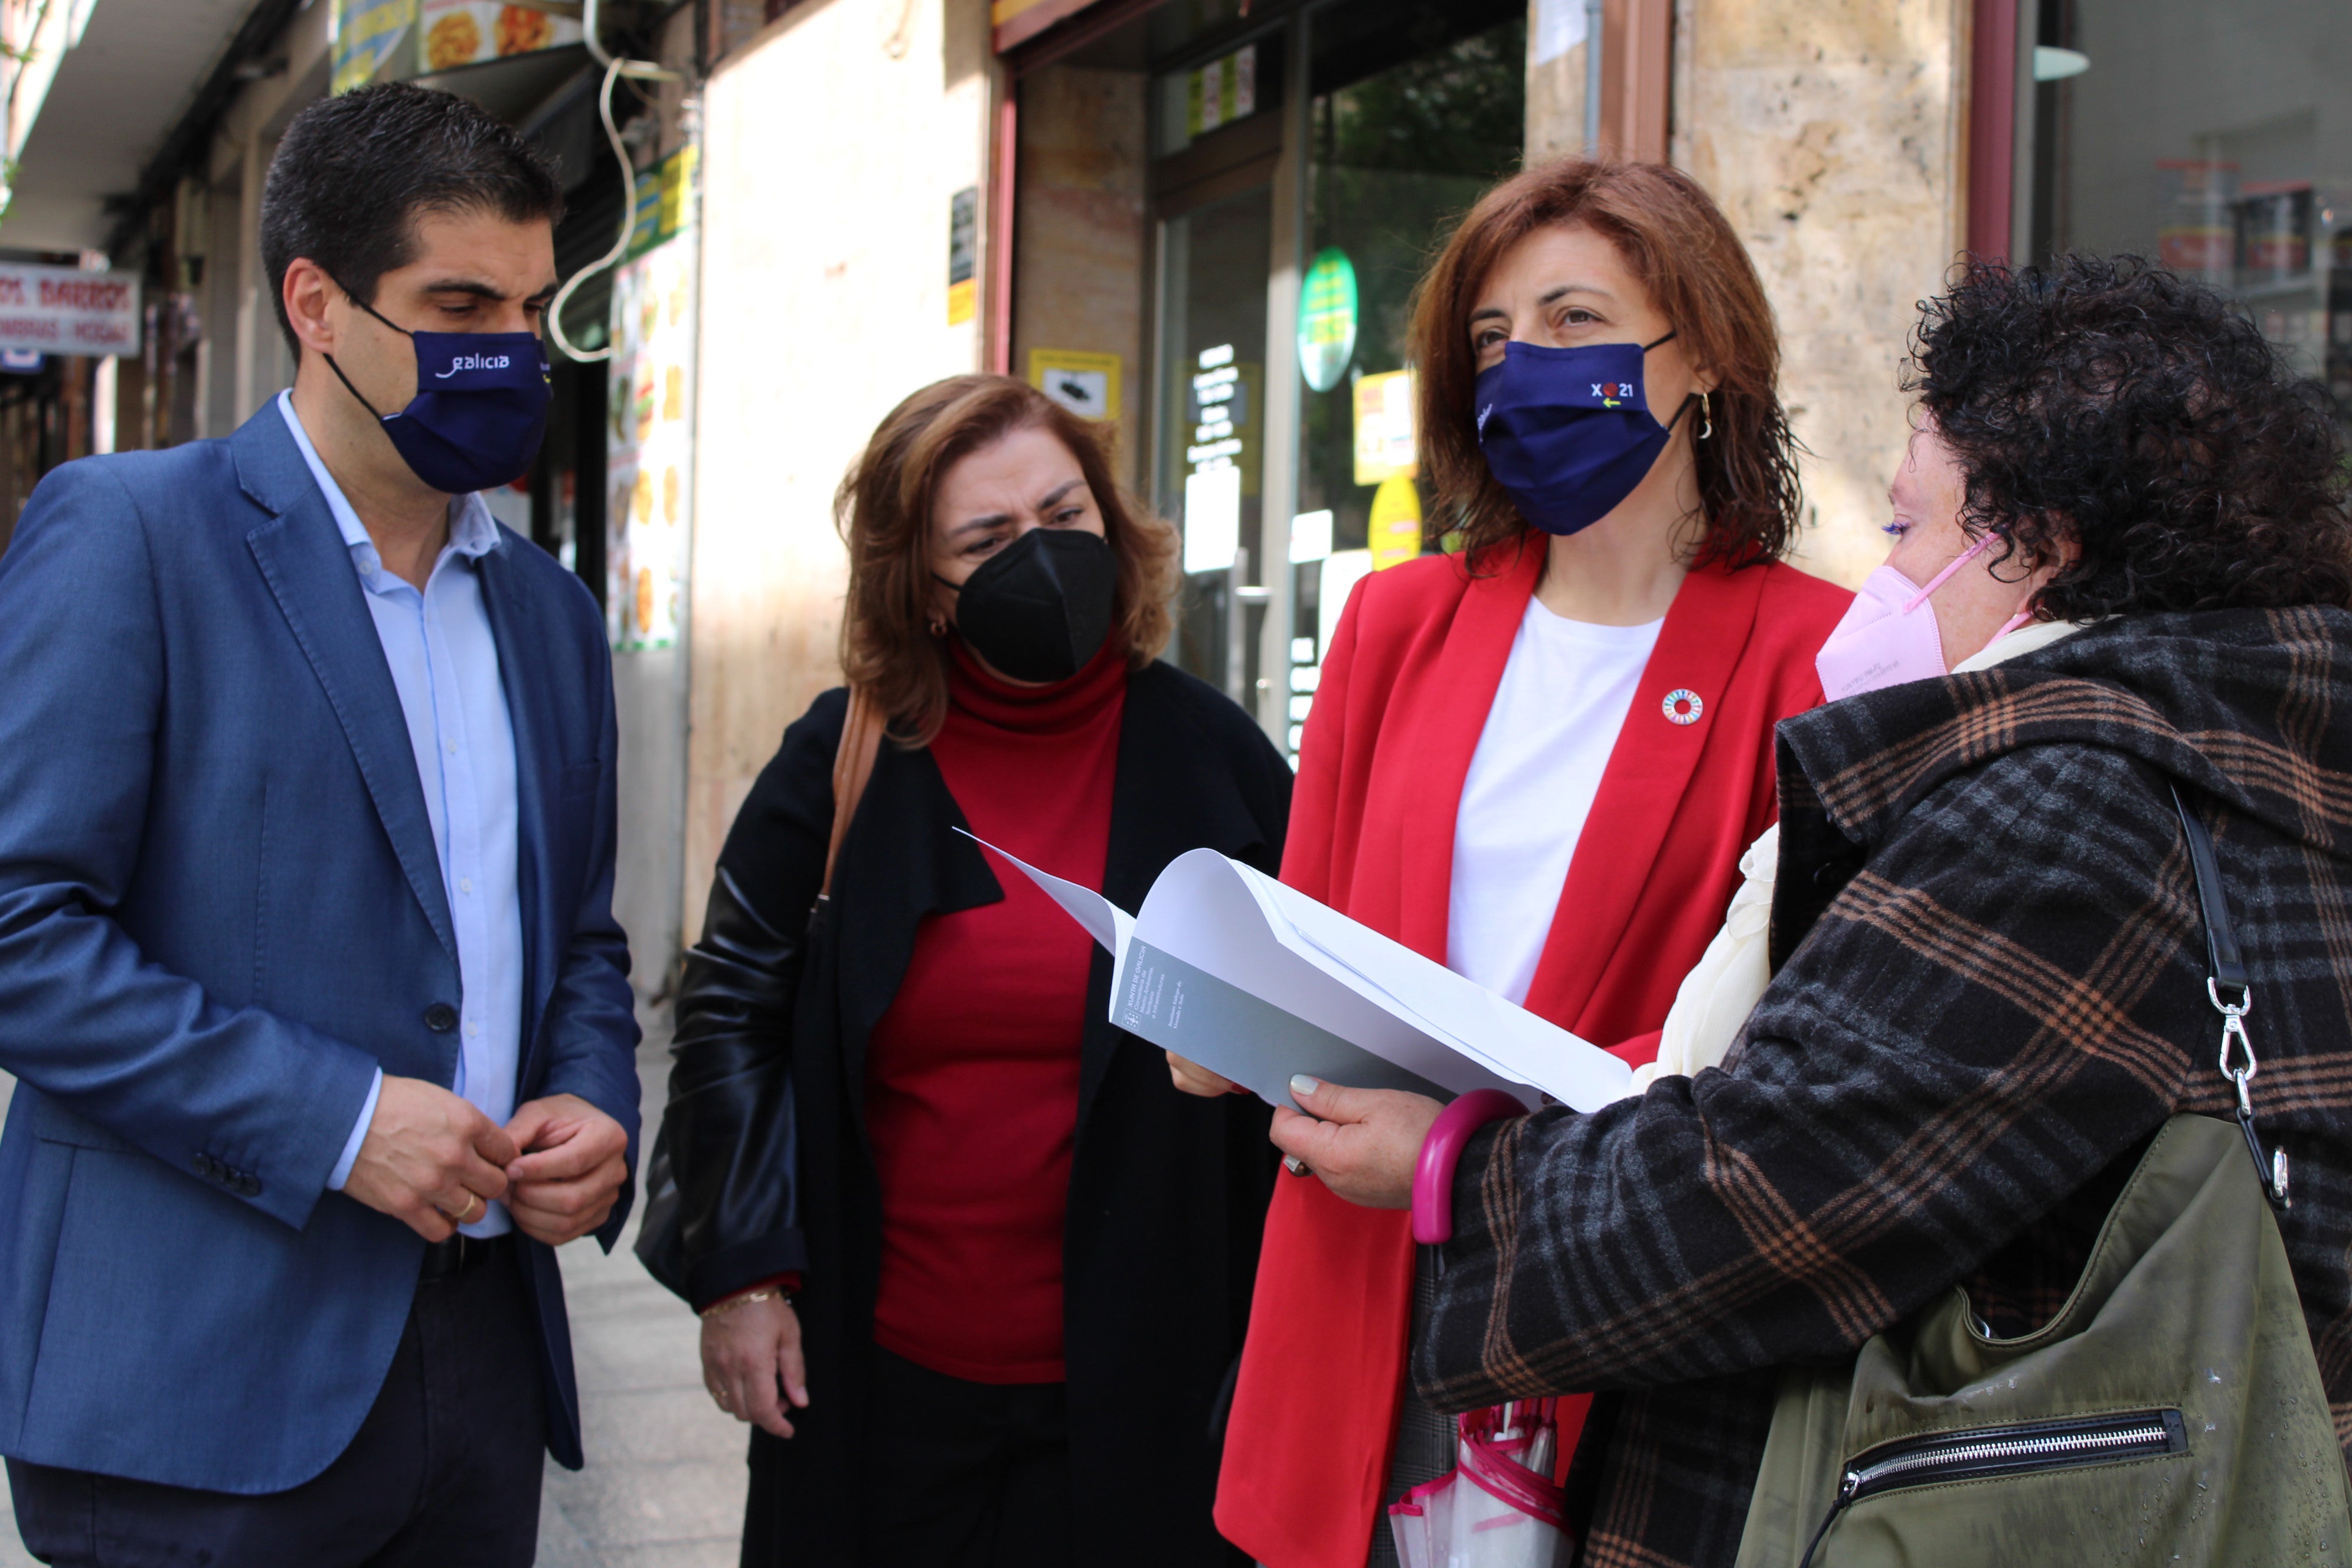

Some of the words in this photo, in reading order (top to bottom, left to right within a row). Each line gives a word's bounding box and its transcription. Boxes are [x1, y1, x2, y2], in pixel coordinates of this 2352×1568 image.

[435, 352, 509, 378] galicia
[1135, 945, 1147, 974] GALICIA
[1133, 974, 1139, 984] DE
[1128, 984, 1137, 1008] XUNTA
